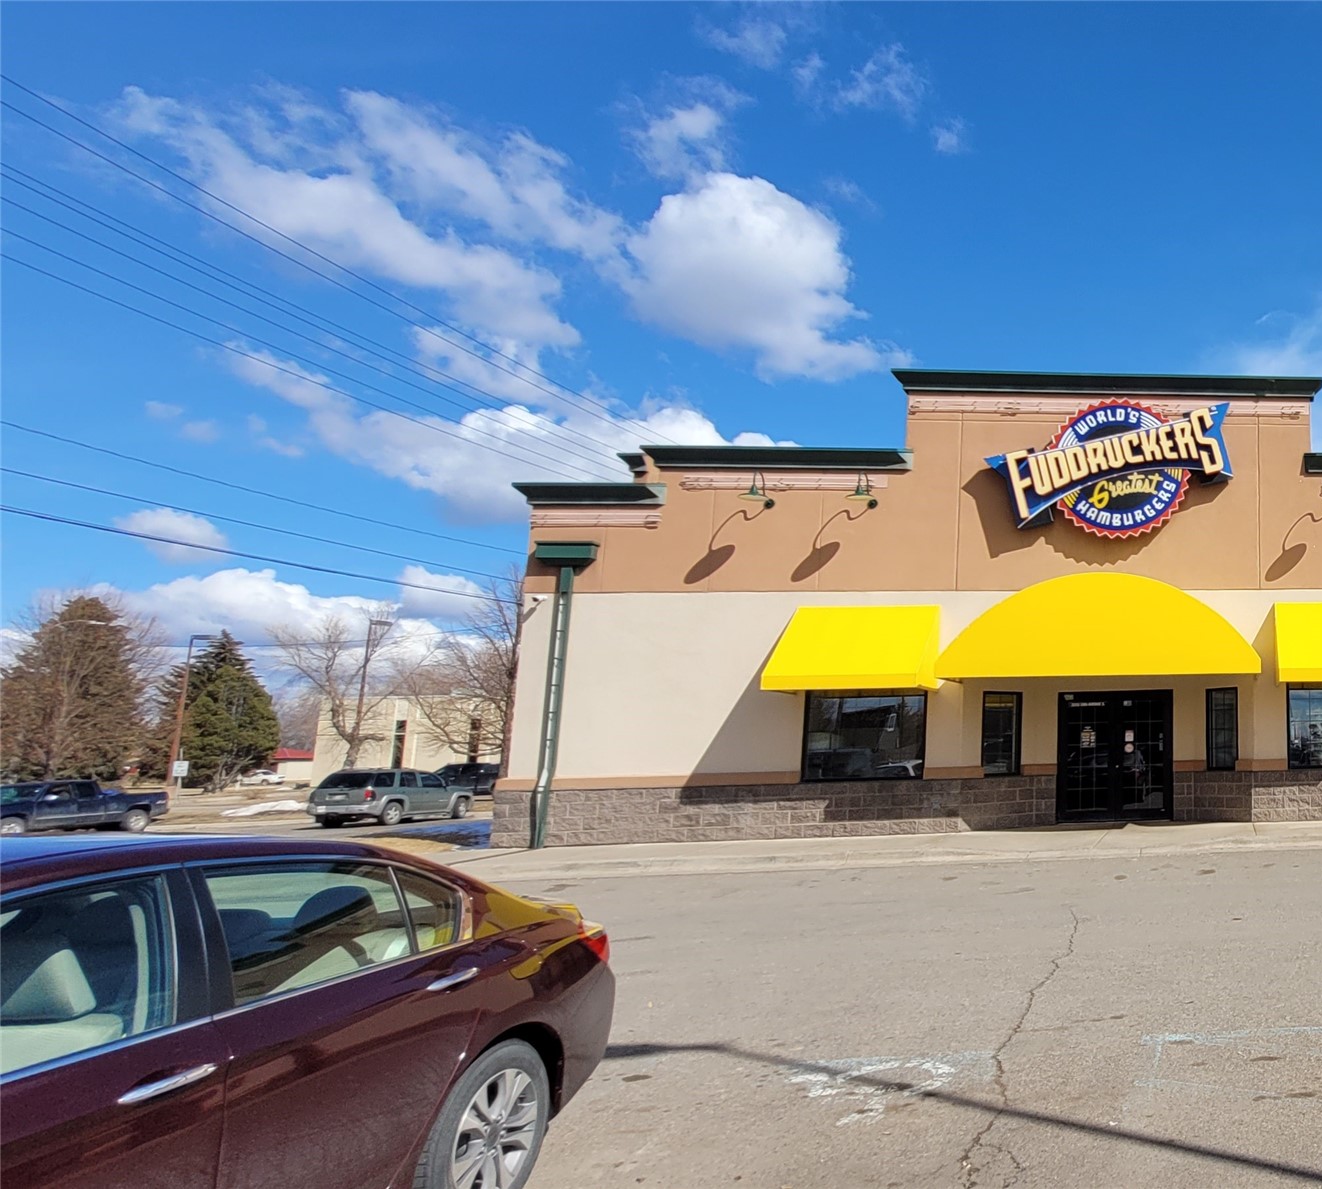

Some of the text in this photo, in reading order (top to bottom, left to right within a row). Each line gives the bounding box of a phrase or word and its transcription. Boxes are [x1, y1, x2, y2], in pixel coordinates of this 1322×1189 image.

[1075, 408, 1140, 435] WORLD'S
[1006, 408, 1224, 519] FUDDRUCKERS
[1076, 480, 1177, 526] HAMBURGERS
[1089, 473, 1163, 508] Greatest
